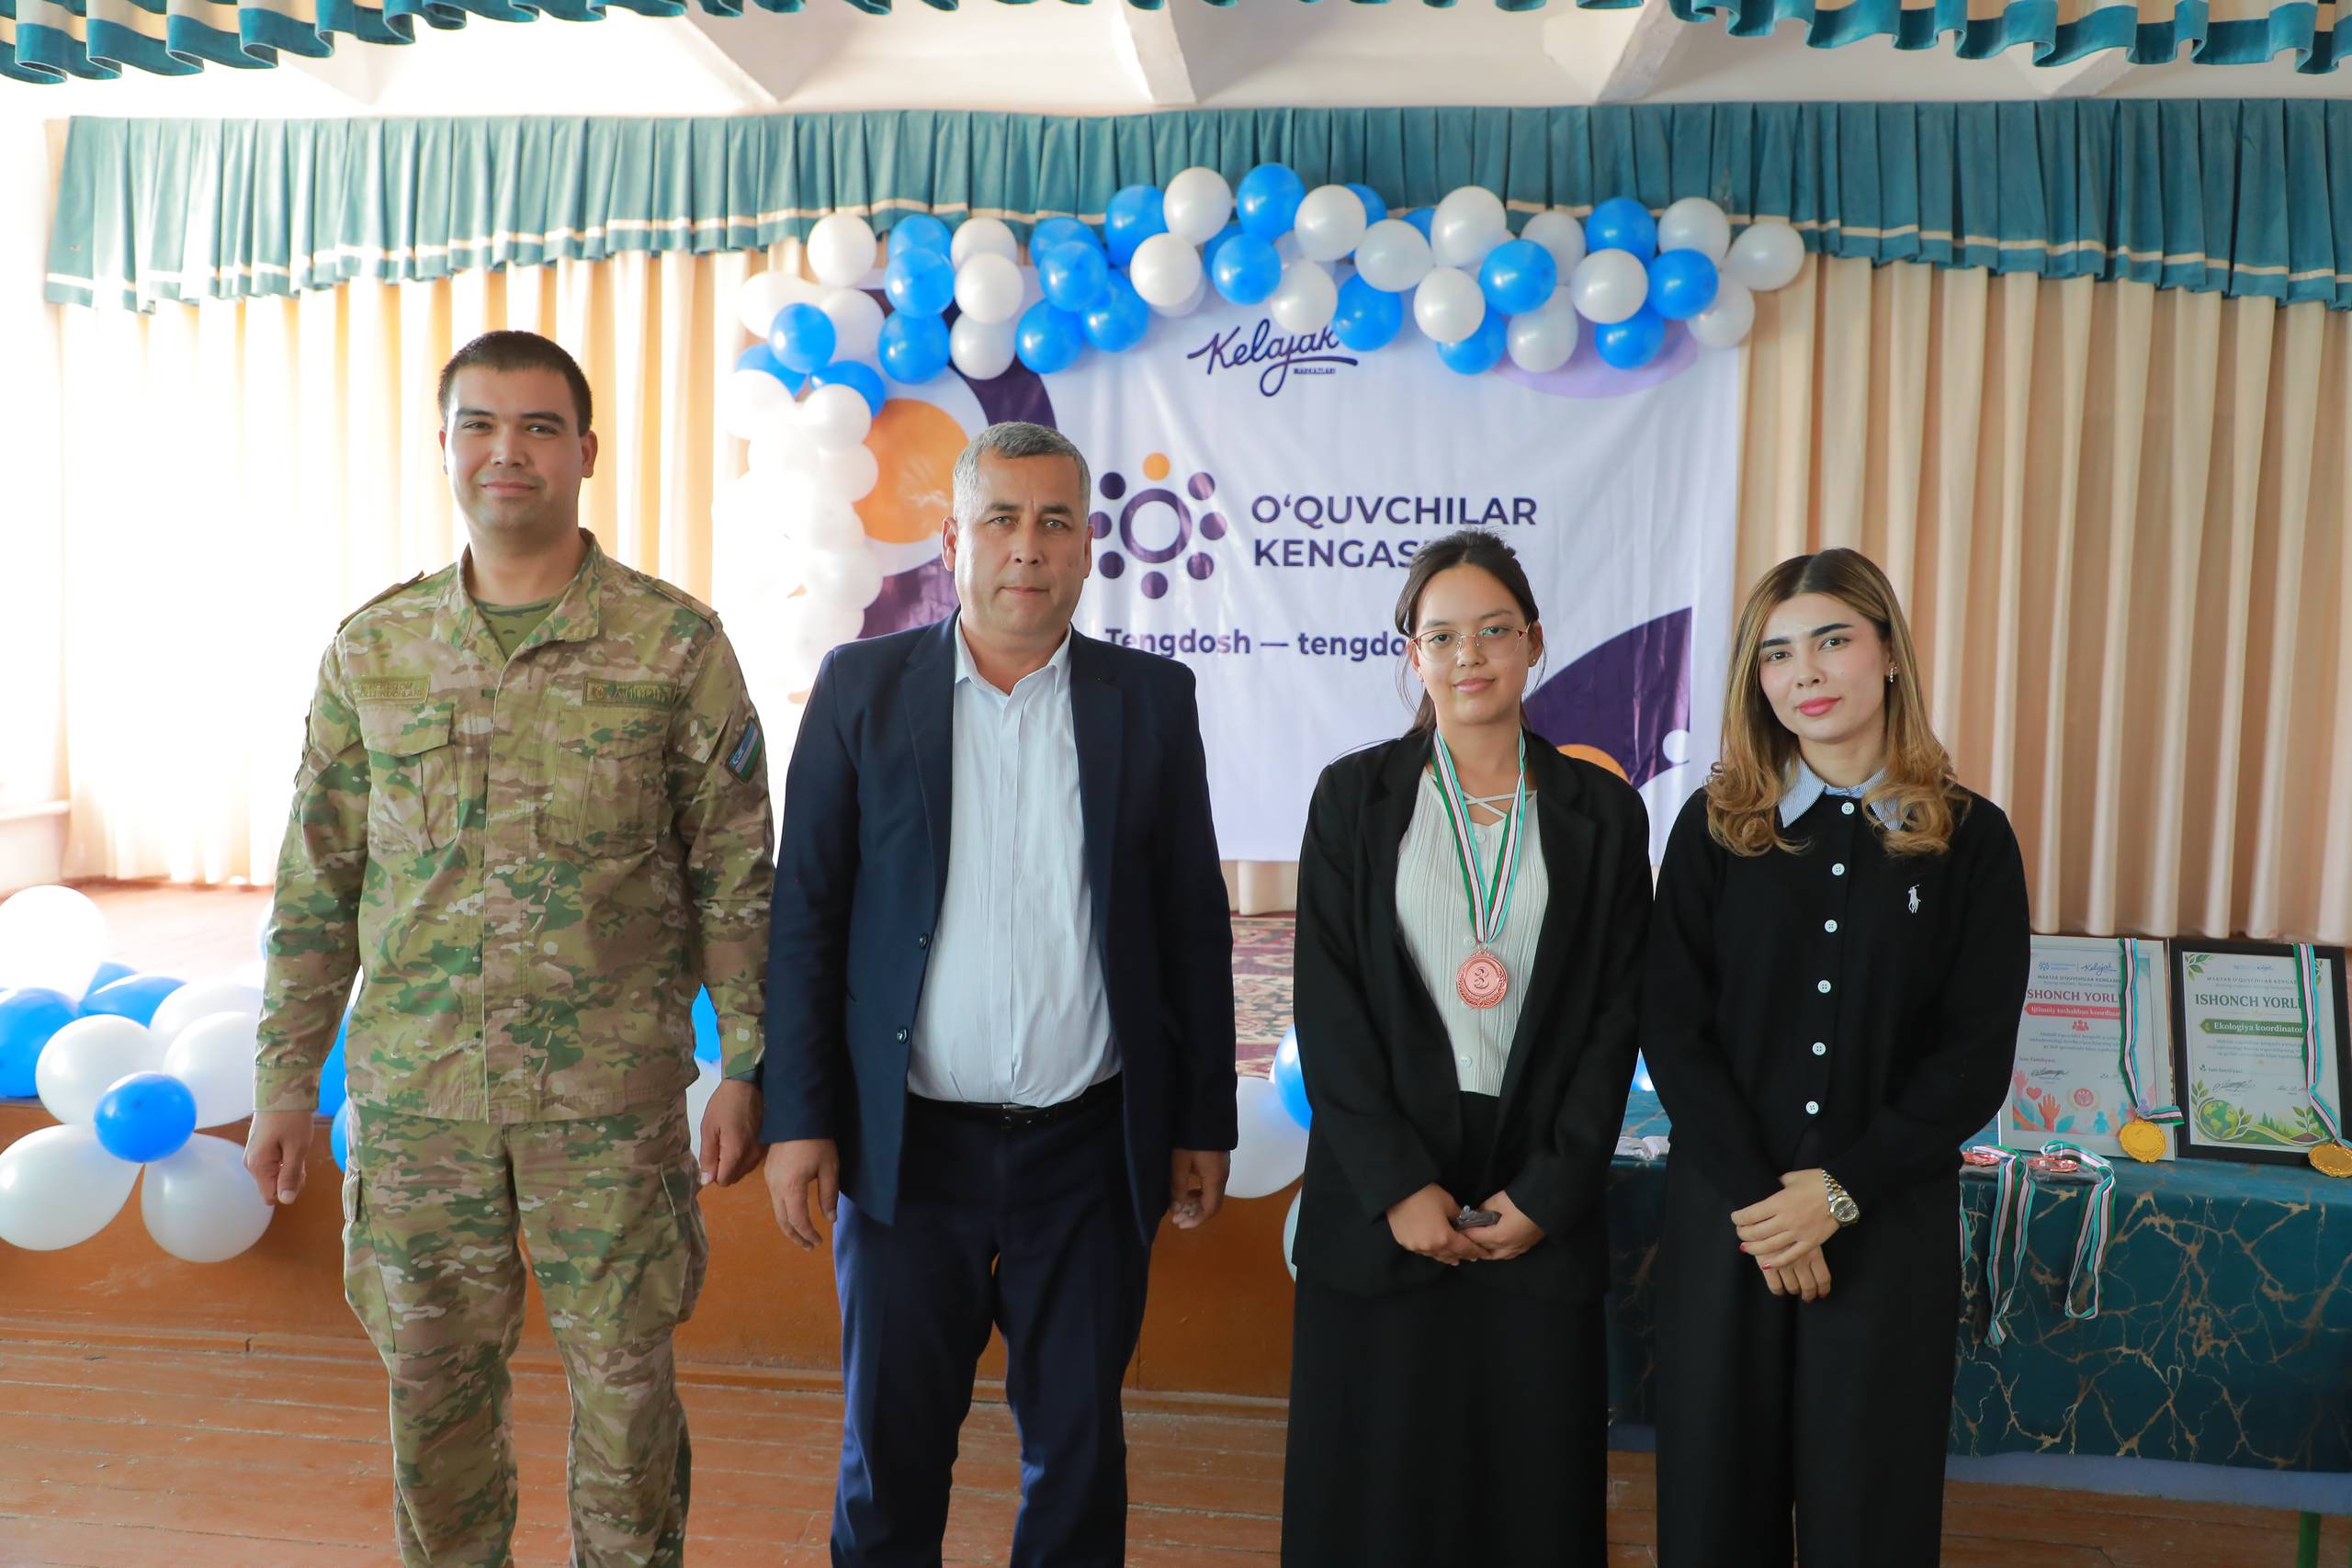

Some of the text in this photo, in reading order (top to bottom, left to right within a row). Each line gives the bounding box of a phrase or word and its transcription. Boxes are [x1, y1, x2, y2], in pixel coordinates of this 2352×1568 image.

[1187, 319, 1358, 397] Kelajak
[1254, 539, 1419, 568] KENGAS
[1104, 627, 1250, 659] Tengdosh
[1297, 631, 1407, 661] tengdo
[1474, 966, 1489, 989] 3
[2027, 988, 2118, 1003] SHONCH YORL
[2195, 994, 2301, 1009] ISHONCH YORL
[2213, 1021, 2254, 1032] Ekologiya
